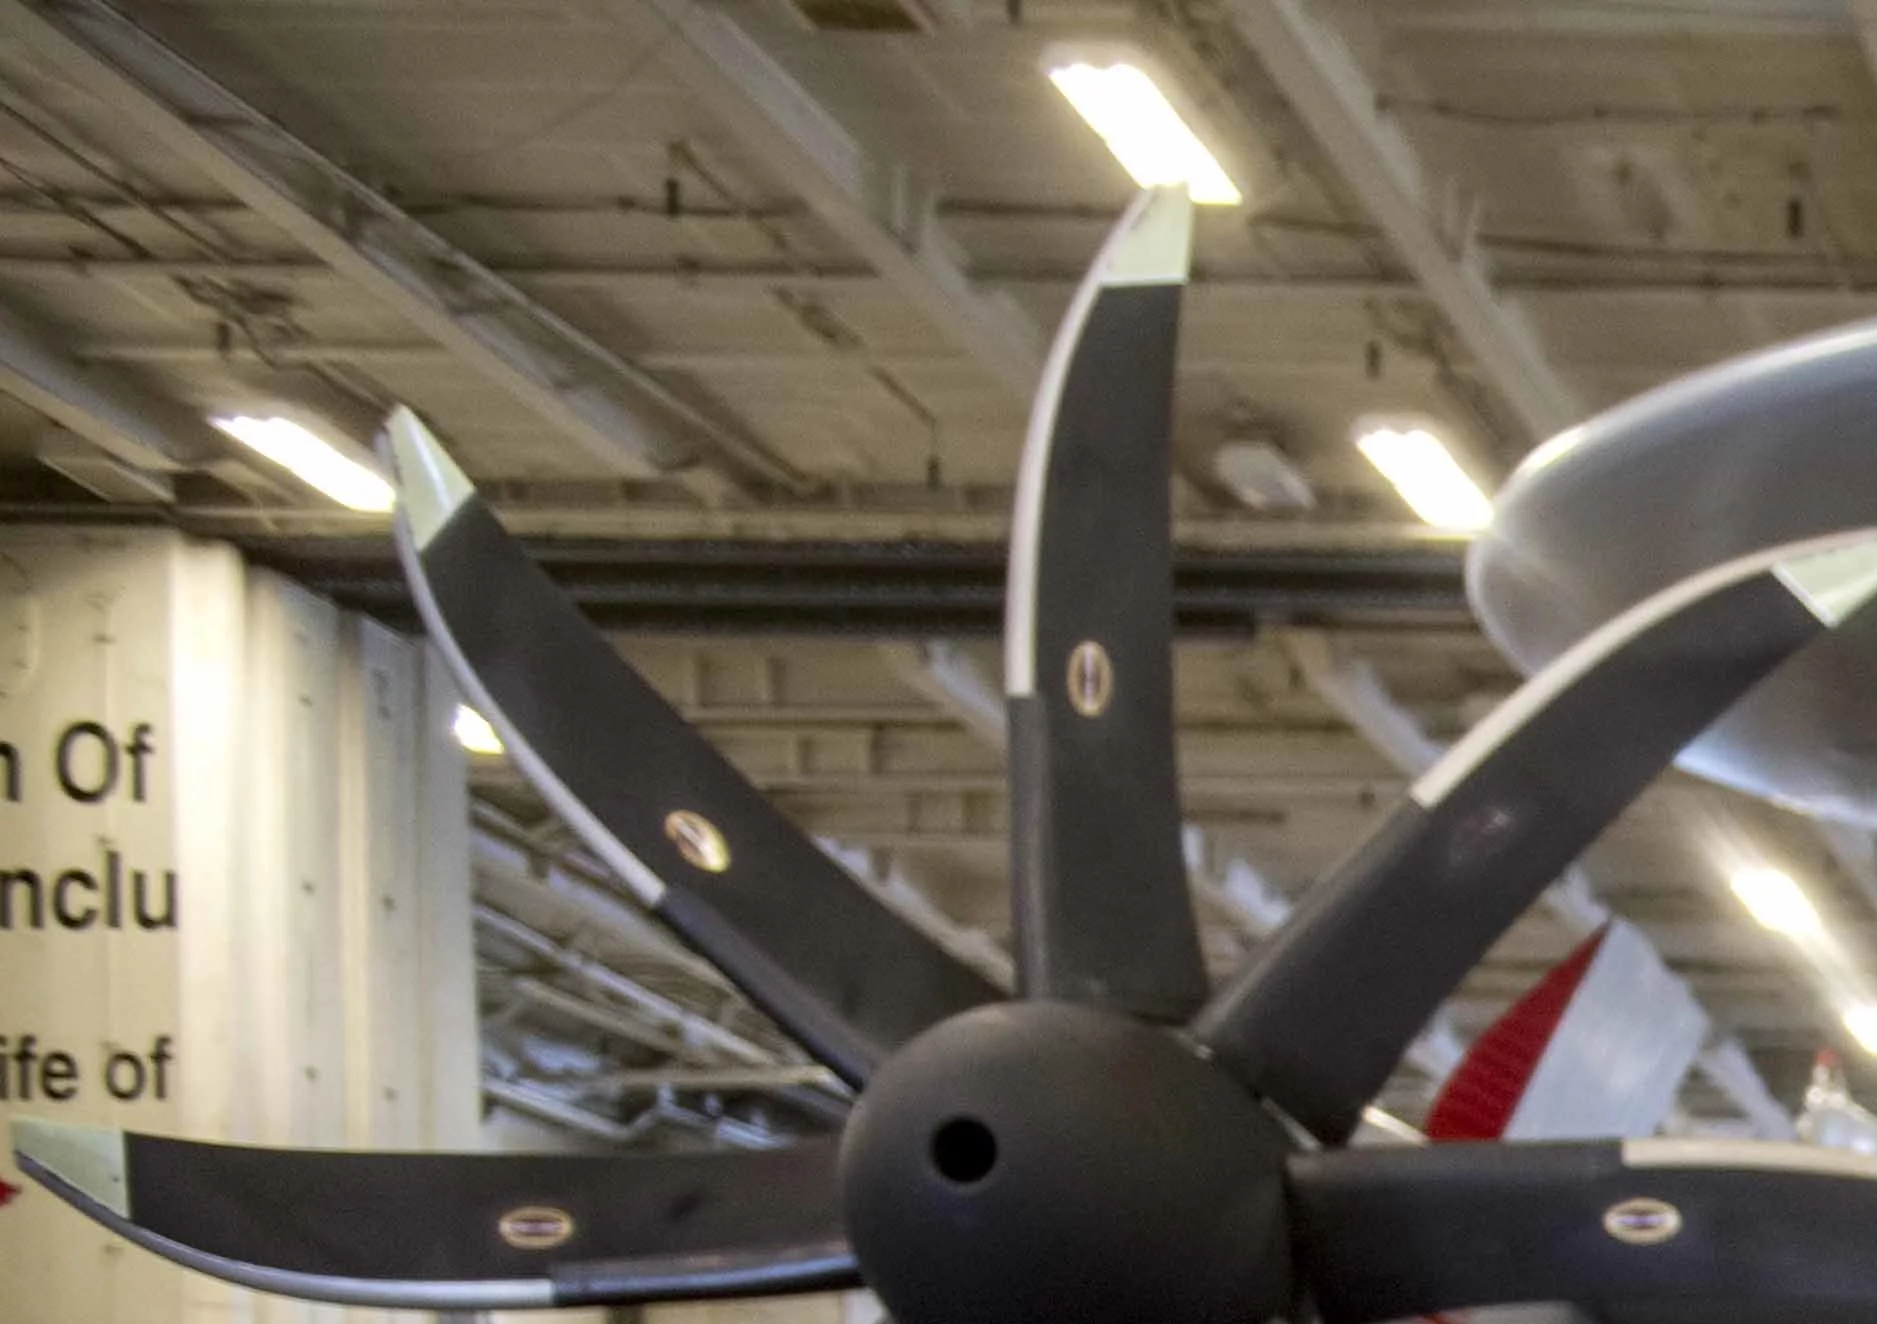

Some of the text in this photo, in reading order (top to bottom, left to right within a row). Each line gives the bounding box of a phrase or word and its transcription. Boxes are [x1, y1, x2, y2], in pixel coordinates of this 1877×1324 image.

[56, 720, 155, 803] Of
[0, 850, 178, 930] nclu
[105, 1033, 175, 1101] of
